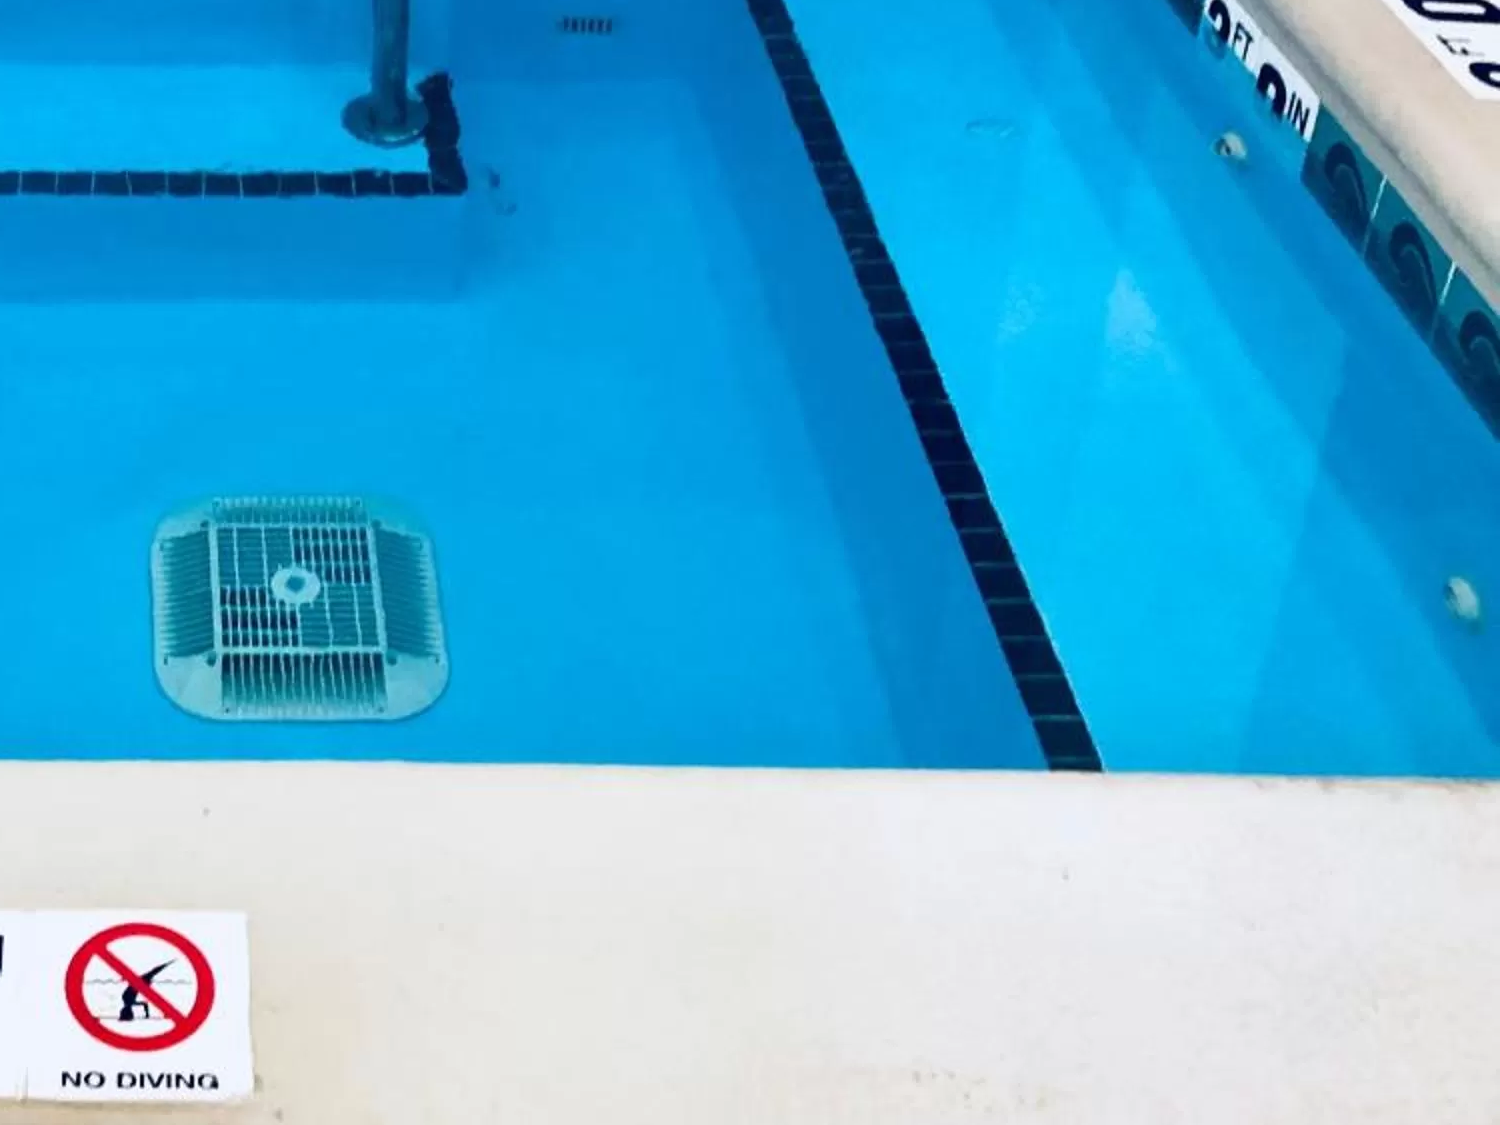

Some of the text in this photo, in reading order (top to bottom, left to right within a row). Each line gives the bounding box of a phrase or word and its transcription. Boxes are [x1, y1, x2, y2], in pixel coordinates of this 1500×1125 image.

[1232, 22, 1254, 61] FT
[1287, 91, 1311, 137] IN
[60, 1071, 219, 1091] NO DIVING
